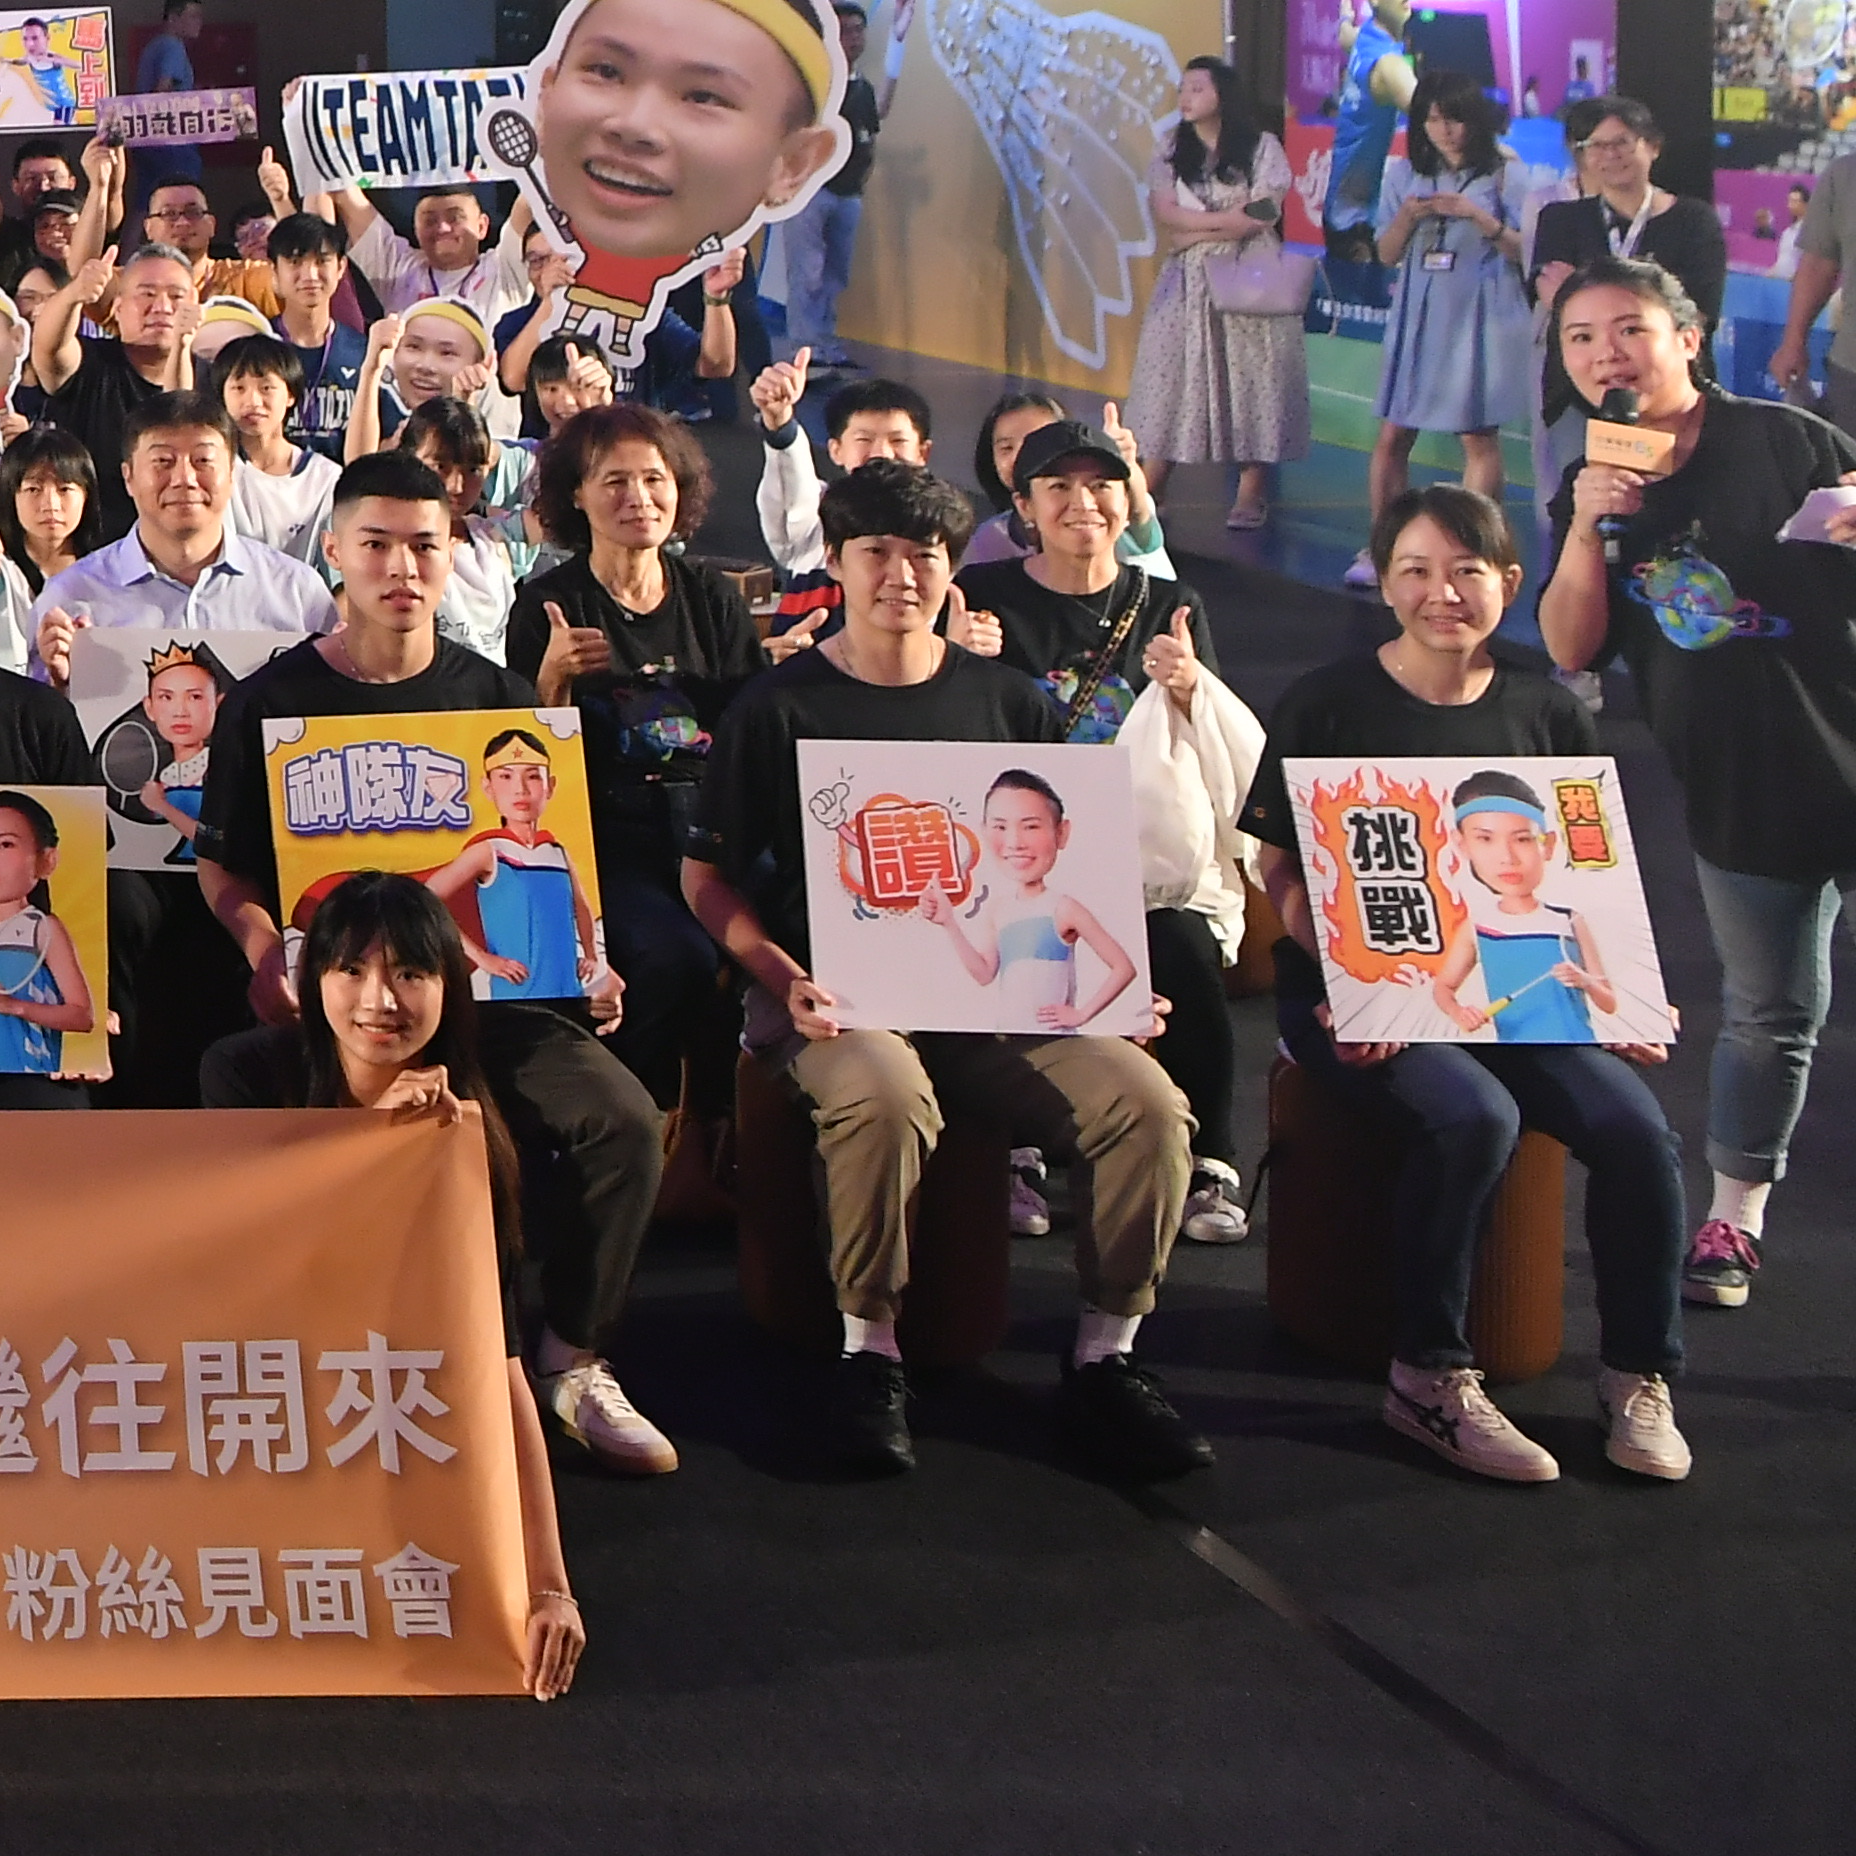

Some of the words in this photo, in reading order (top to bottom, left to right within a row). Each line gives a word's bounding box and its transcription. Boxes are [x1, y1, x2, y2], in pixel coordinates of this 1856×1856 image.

[72, 16, 106, 109] 馬上到
[286, 743, 470, 831] 神隊友
[1555, 782, 1612, 864] 我要
[865, 808, 961, 897] 讚
[1351, 808, 1438, 950] 挑戰
[2, 1541, 460, 1642] 粉絲見面會
